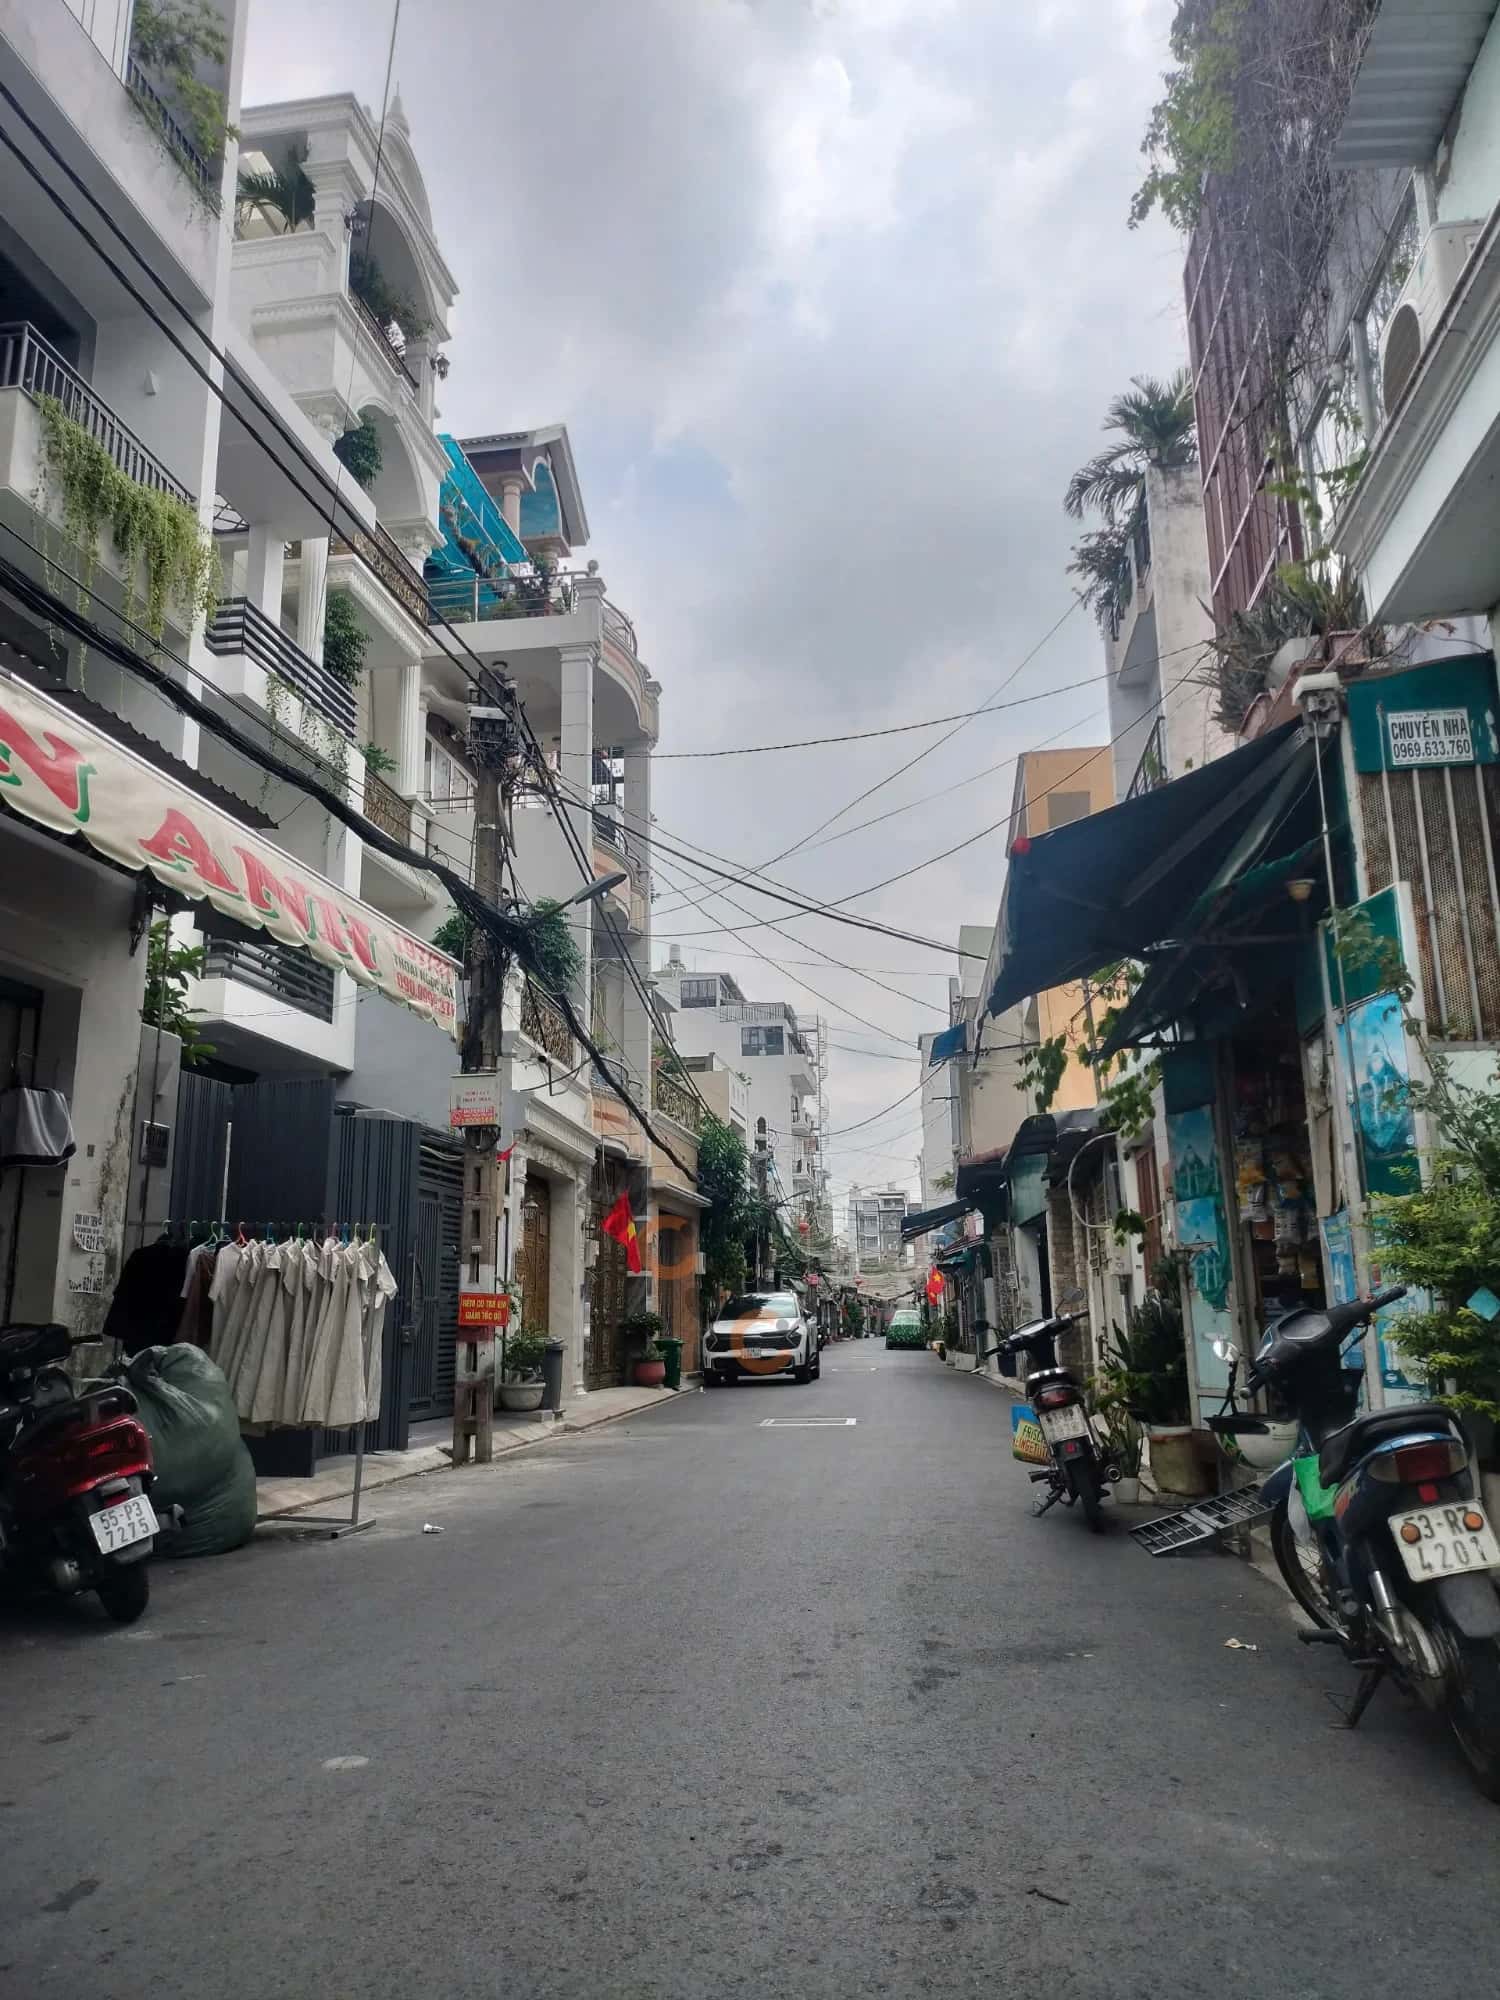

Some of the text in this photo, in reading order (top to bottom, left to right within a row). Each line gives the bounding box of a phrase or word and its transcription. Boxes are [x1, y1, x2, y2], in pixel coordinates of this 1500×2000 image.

[1393, 739, 1471, 758] 0969.633.760
[138, 807, 381, 976] ANH
[100, 1502, 143, 1530] 55-P3
[105, 1519, 149, 1548] 7275
[1417, 1536, 1487, 1573] 4201
